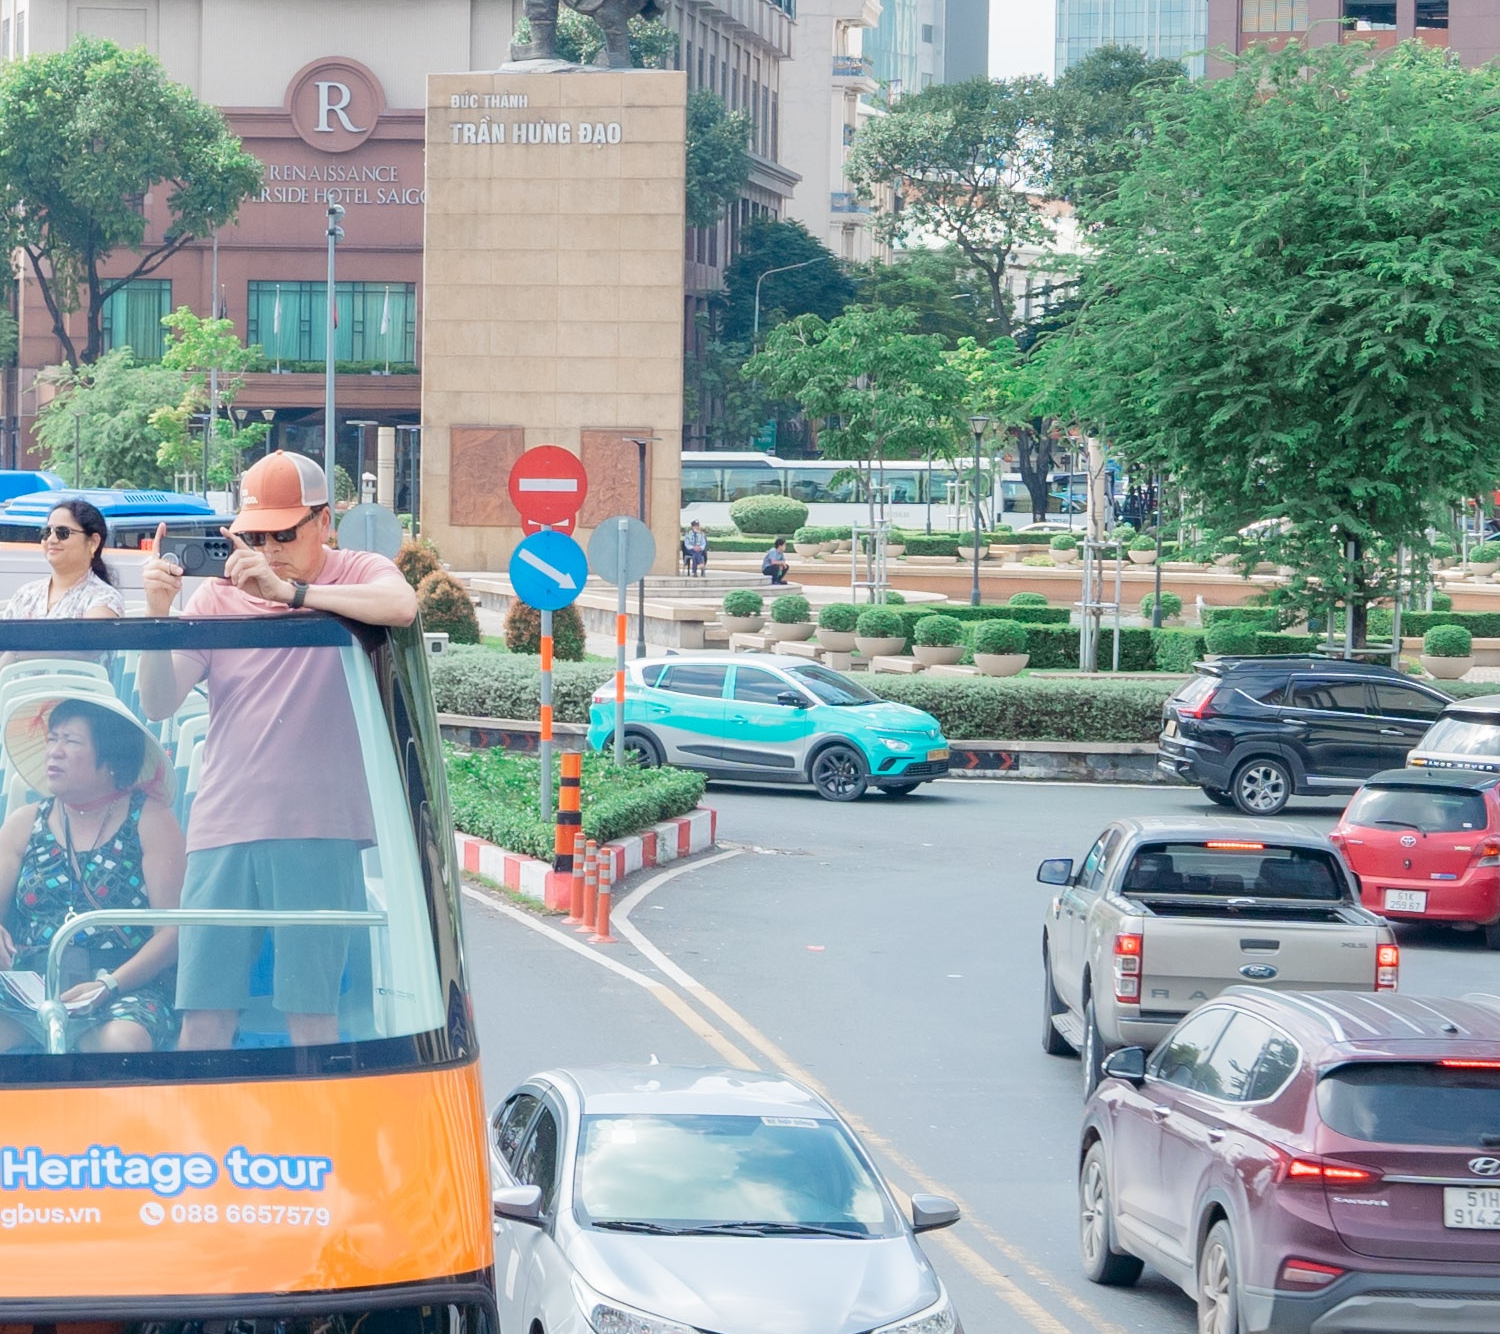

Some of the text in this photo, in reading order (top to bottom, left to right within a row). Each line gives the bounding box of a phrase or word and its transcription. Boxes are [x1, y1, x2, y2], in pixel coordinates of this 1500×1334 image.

[313, 81, 367, 133] R
[450, 91, 529, 109] ĐỨC THÁNH
[450, 115, 622, 150] TRẦN HƯNG ĐẠO
[269, 164, 400, 183] RENAISSANCE
[314, 187, 373, 205] HOTEL
[1456, 762, 1495, 771] ROVER
[1, 1147, 214, 1196] Heritage
[226, 1149, 328, 1187] tour
[1466, 1191, 1500, 1208] 51H
[170, 1203, 220, 1224] 088
[225, 1204, 331, 1226] 6657579
